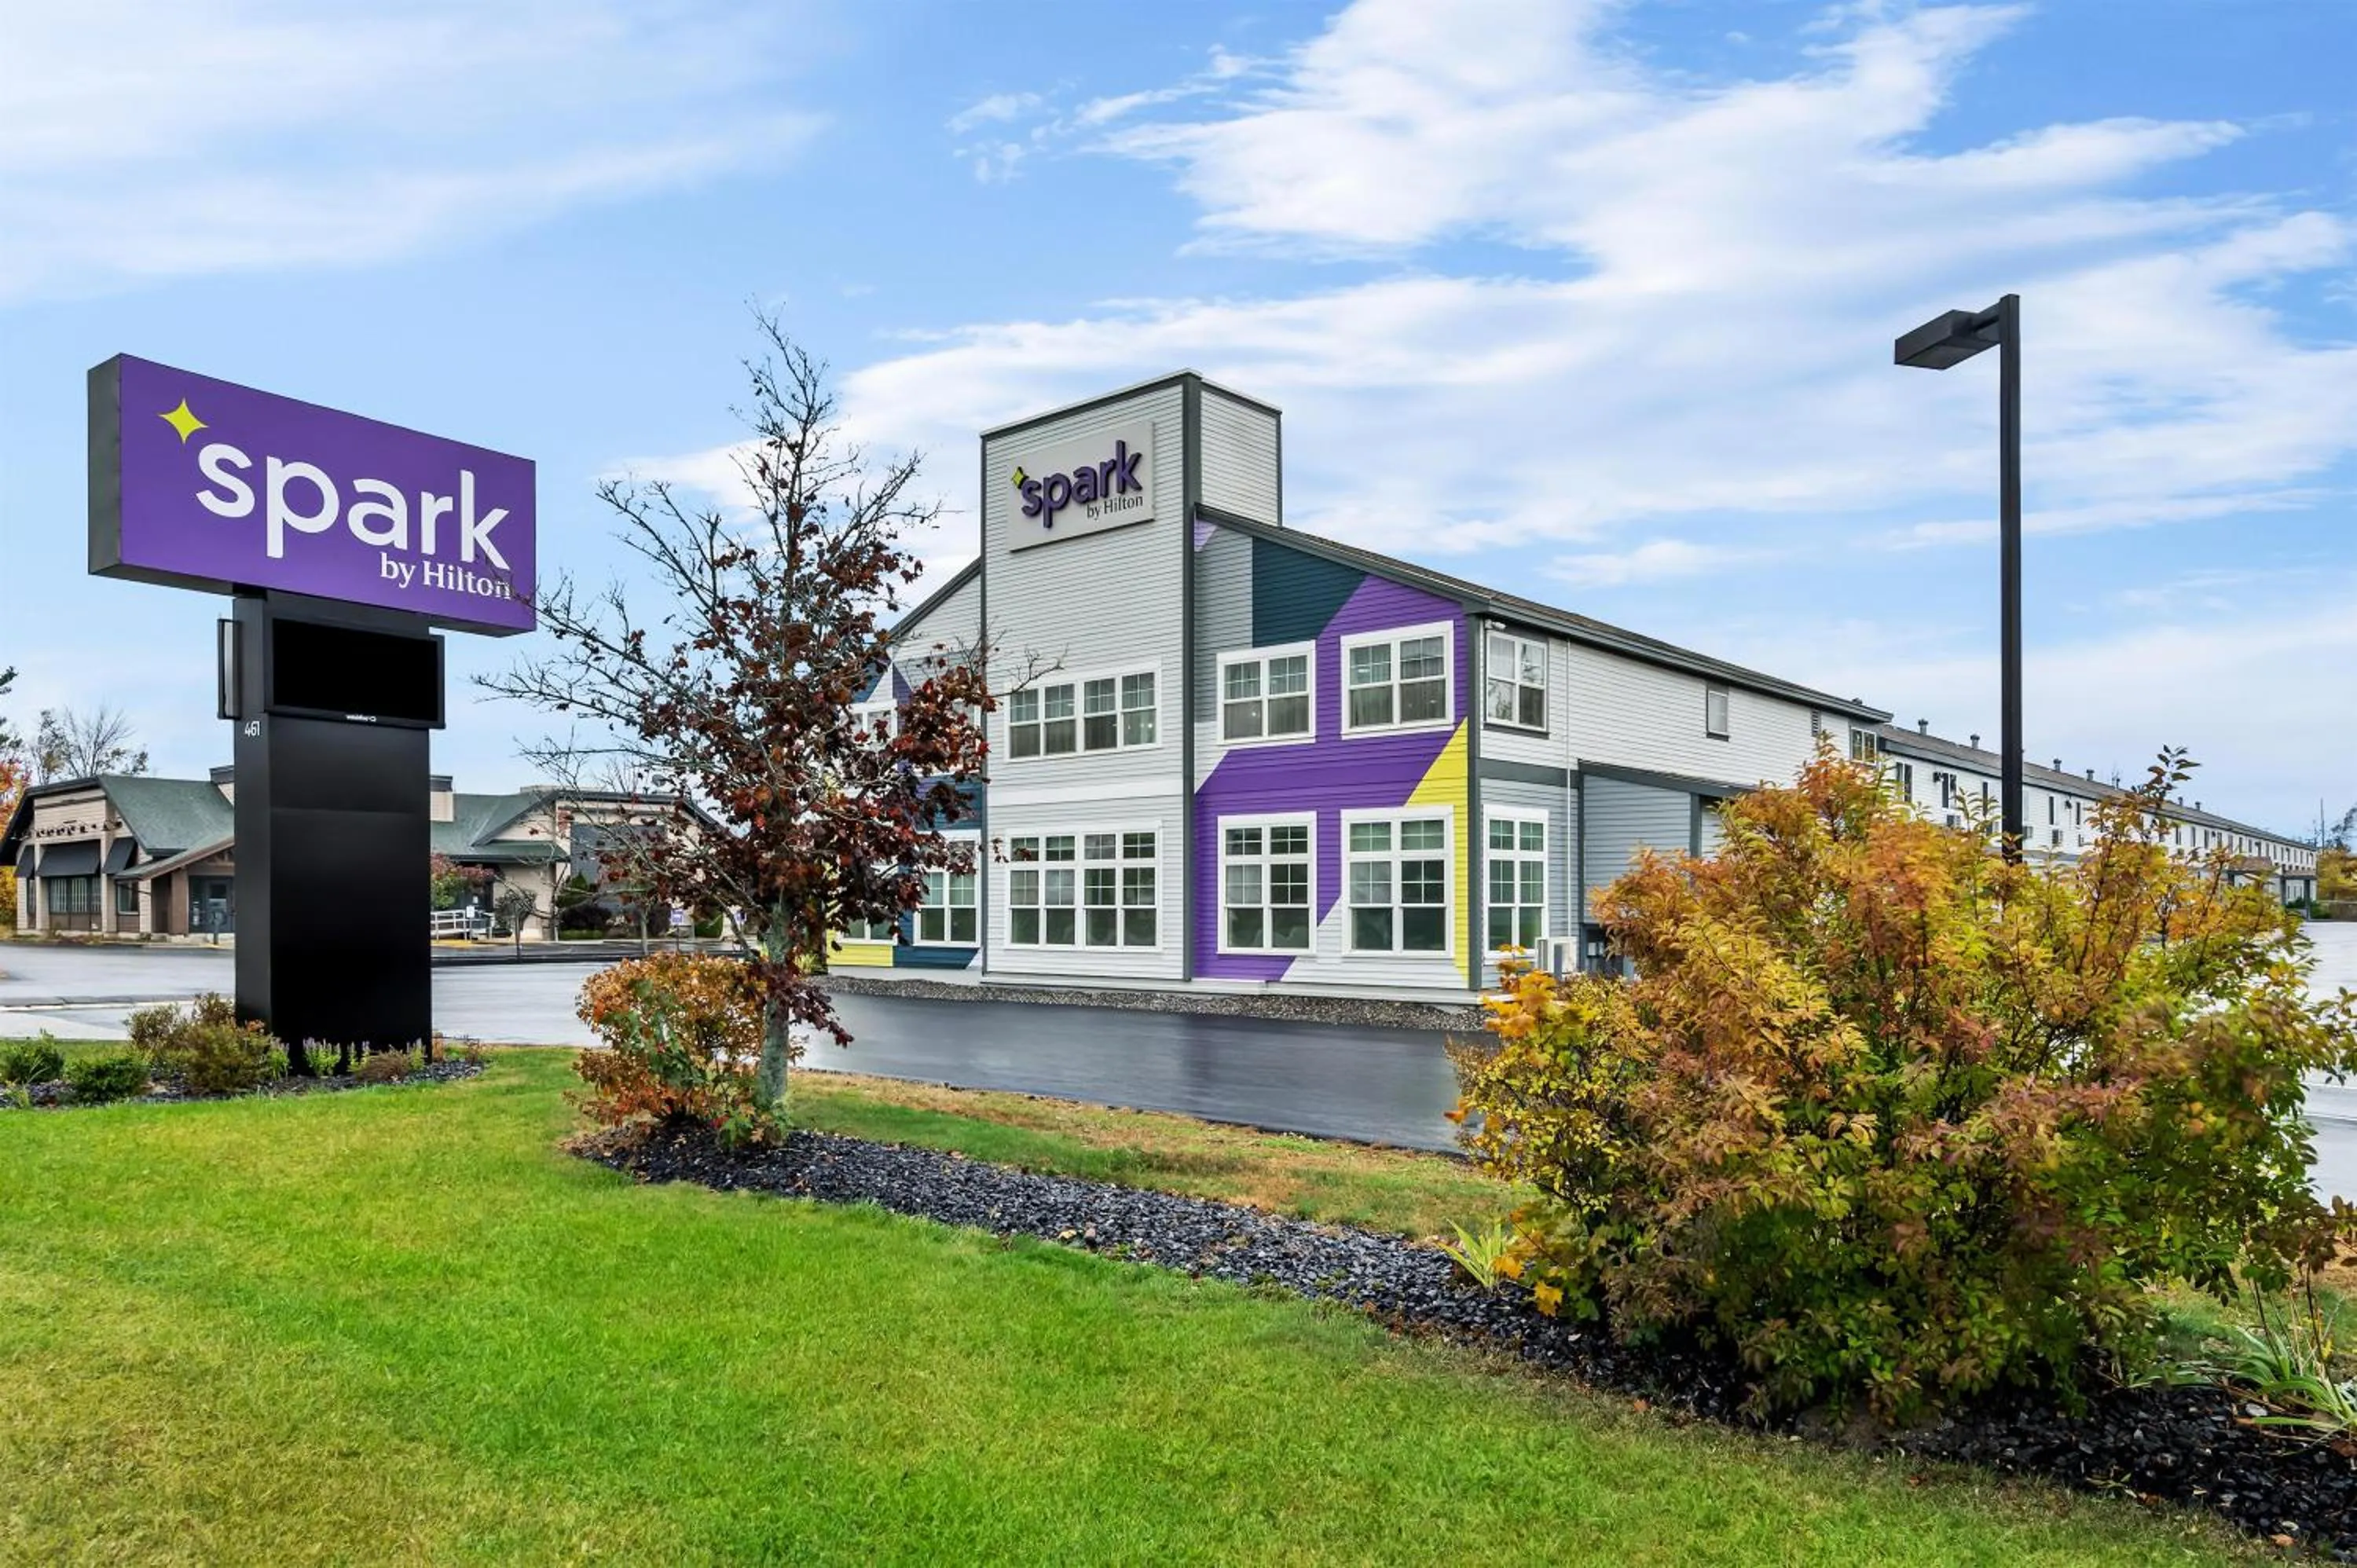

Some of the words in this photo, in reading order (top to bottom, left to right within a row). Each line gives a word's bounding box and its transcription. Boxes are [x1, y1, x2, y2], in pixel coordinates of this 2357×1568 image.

[196, 443, 510, 570] spark
[1021, 440, 1142, 529] spark
[1087, 504, 1100, 521] by
[1104, 496, 1143, 514] Hilton
[380, 551, 416, 588] by
[422, 560, 511, 600] Hilton
